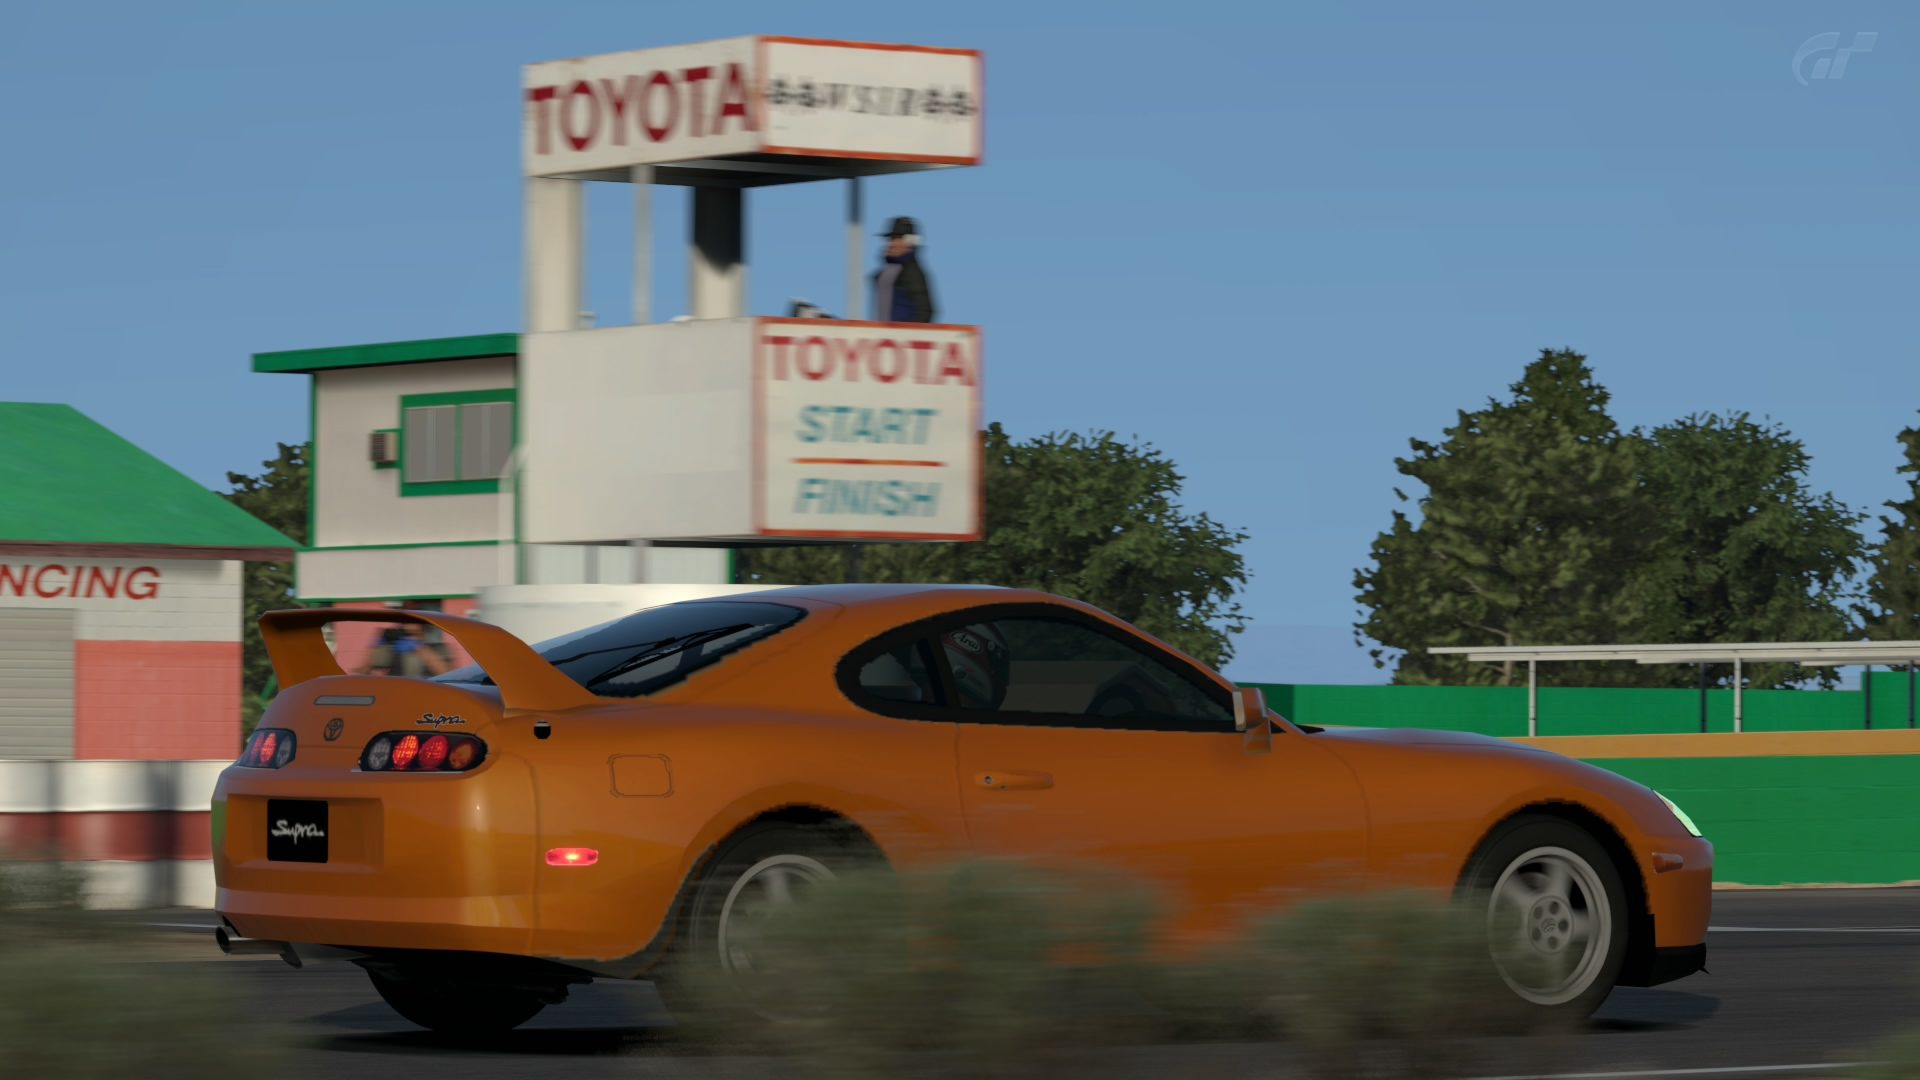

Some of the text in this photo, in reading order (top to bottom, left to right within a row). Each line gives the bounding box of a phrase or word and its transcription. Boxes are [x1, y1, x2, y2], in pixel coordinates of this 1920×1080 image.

[526, 62, 759, 156] TOYOTA
[761, 335, 977, 387] TOYOTA
[796, 404, 940, 446] START
[792, 477, 944, 518] FINISH
[0, 564, 162, 600] NCING
[416, 713, 466, 729] Supra
[271, 819, 325, 846] Supra
